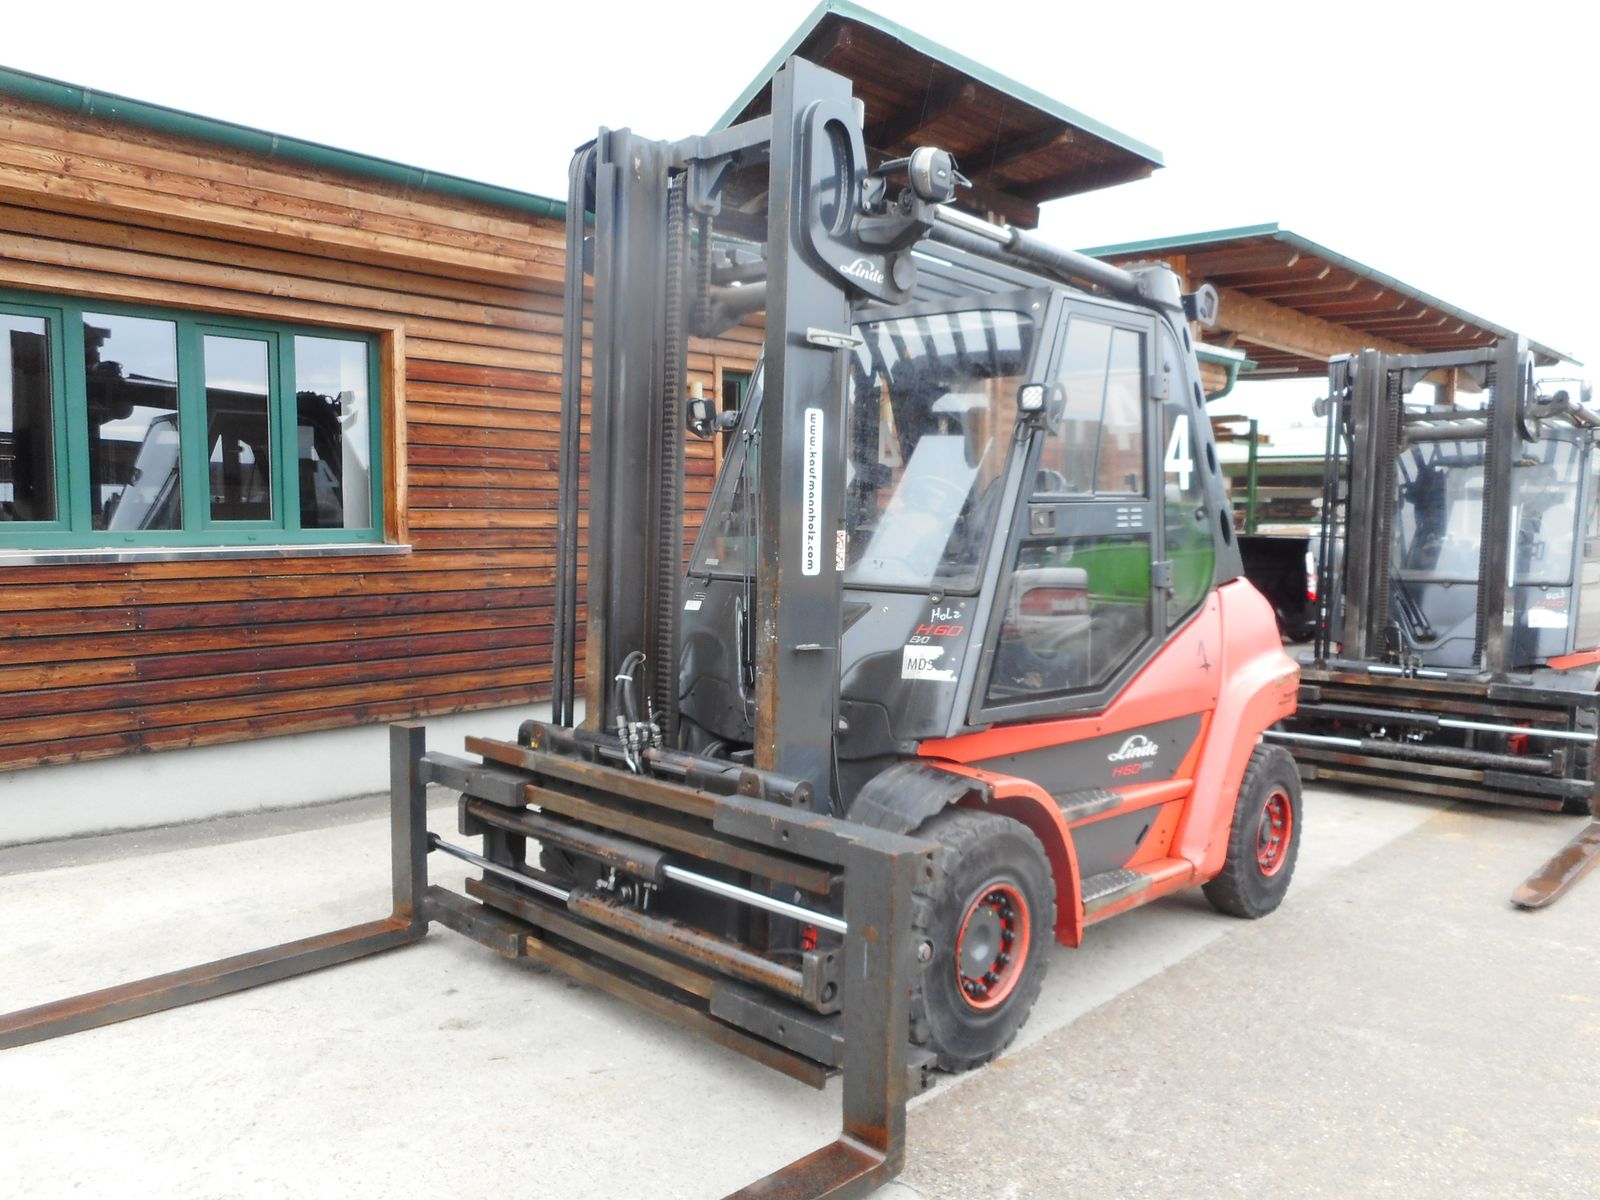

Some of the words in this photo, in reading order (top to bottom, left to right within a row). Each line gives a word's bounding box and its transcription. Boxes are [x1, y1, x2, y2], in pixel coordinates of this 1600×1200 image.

[839, 258, 884, 284] Linde
[1164, 414, 1193, 491] 4
[807, 413, 817, 570] www.kaufmannholz.com
[1107, 734, 1159, 761] Linde
